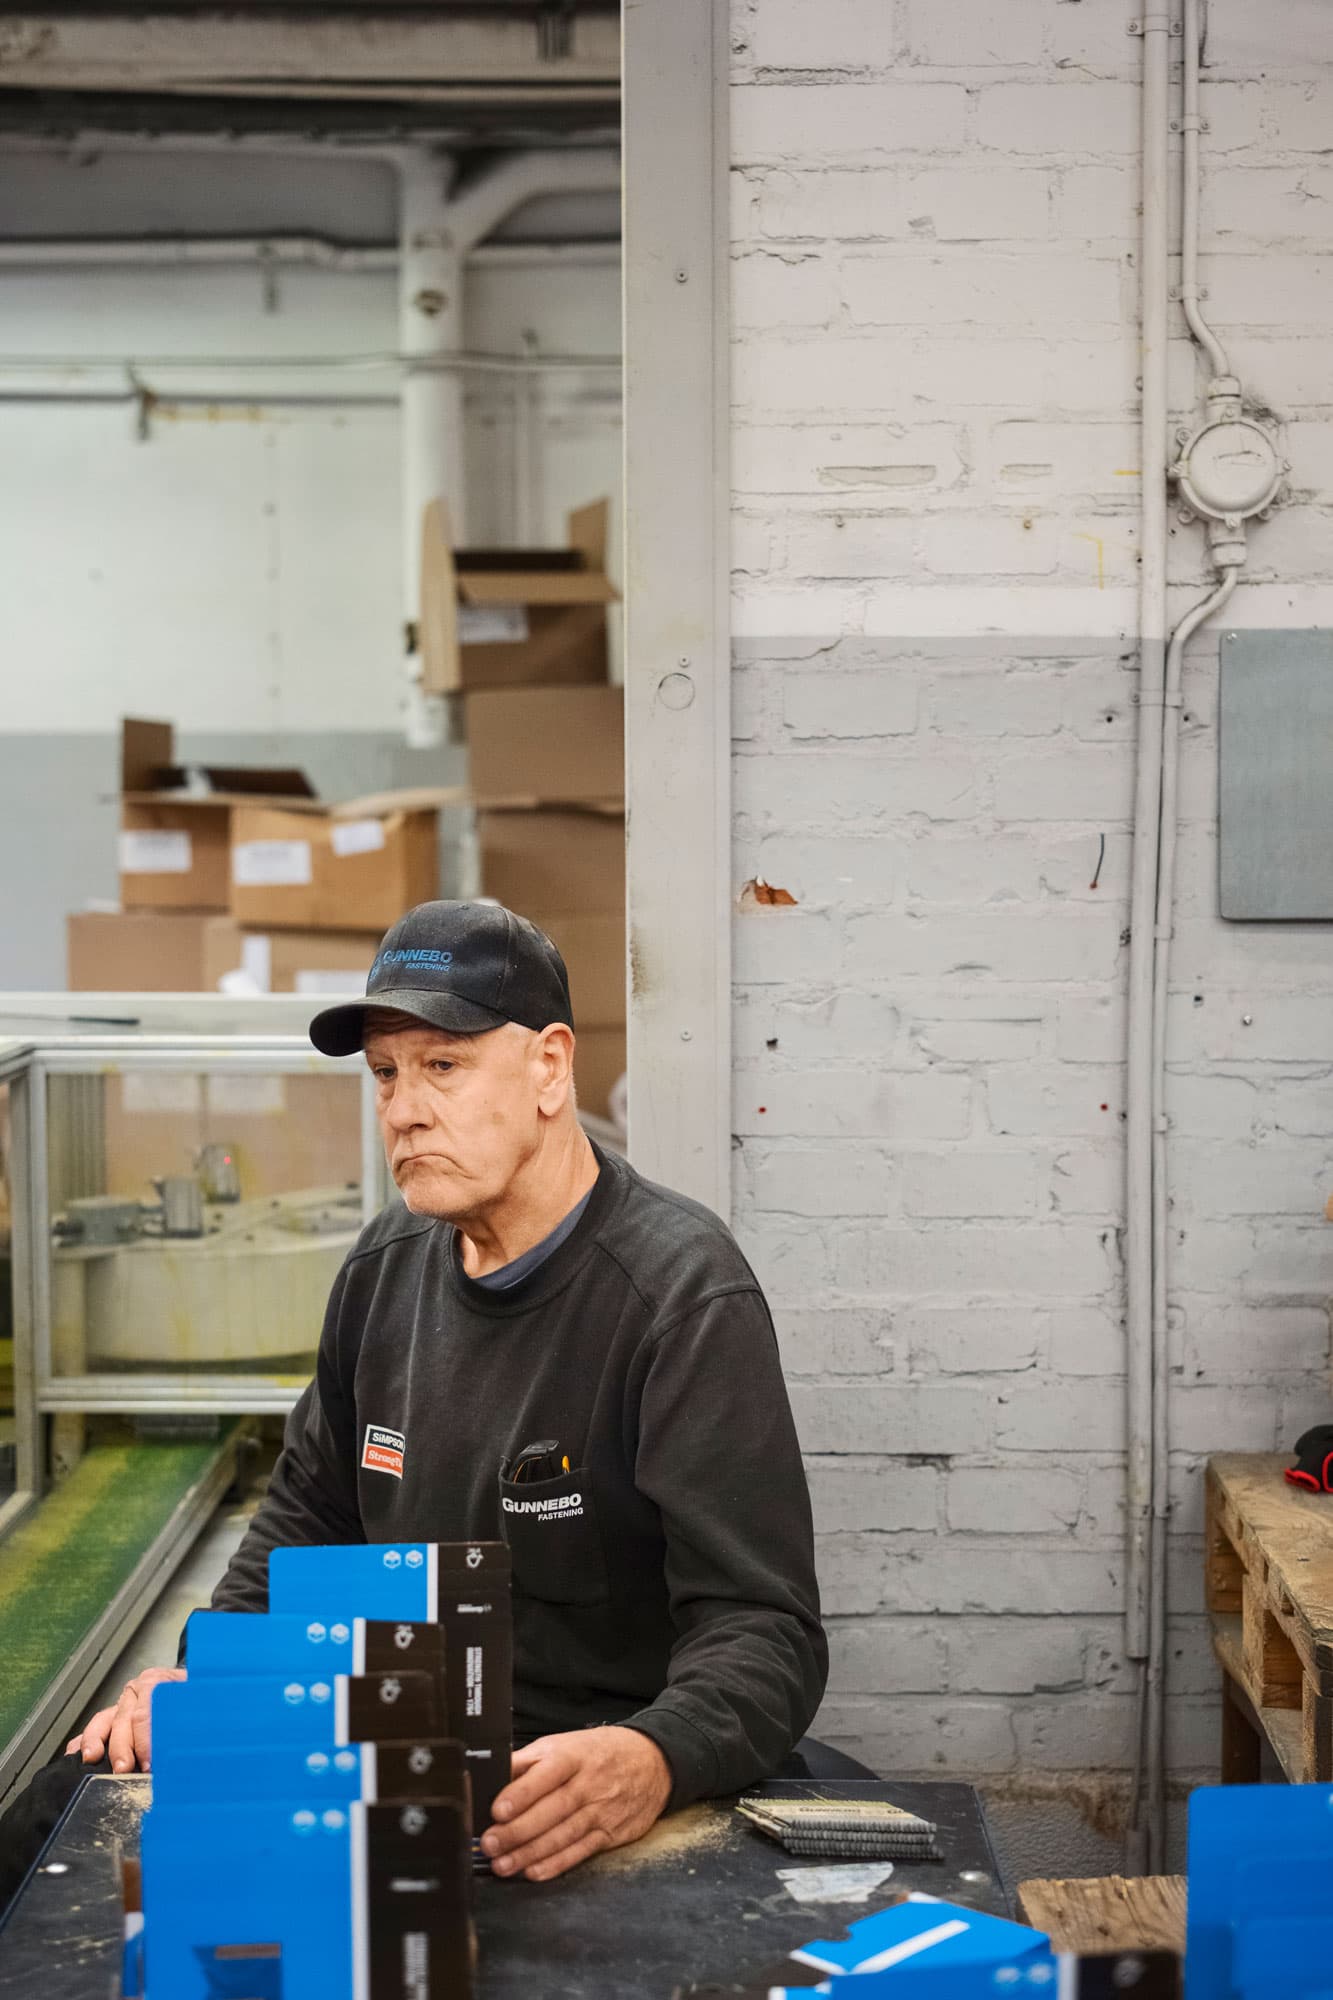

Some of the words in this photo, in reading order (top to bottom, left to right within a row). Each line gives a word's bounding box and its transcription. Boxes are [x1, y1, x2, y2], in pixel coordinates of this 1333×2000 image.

[383, 949, 453, 963] GUNNEBO
[405, 962, 450, 972] FASTENING
[502, 1493, 582, 1513] GUNNEBO
[538, 1507, 584, 1521] FASTENING
